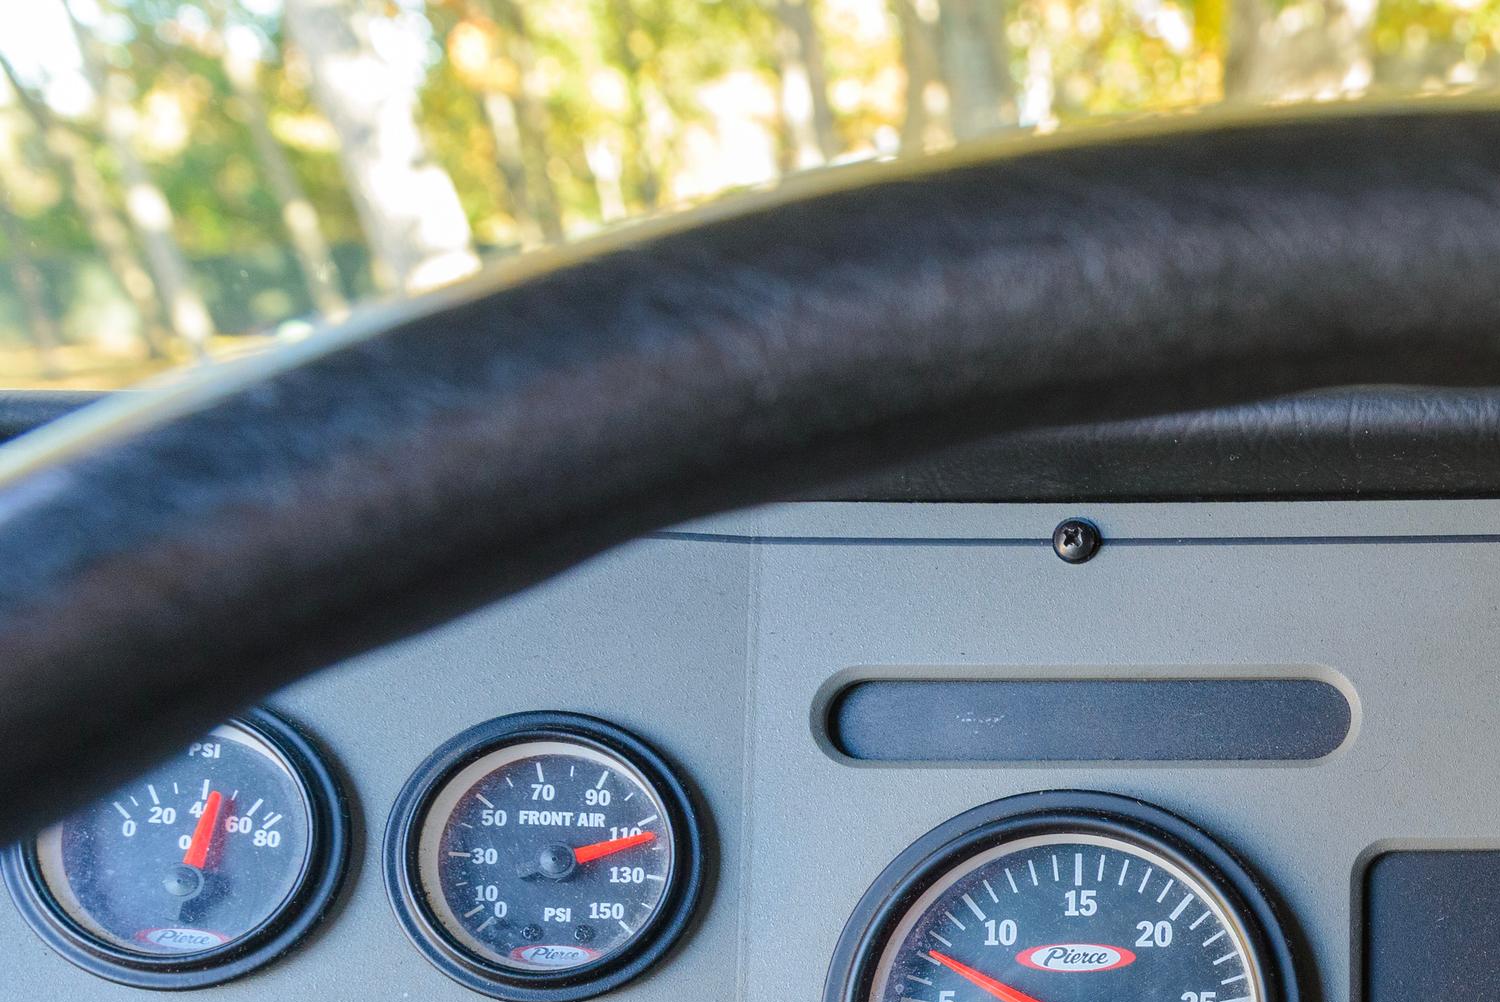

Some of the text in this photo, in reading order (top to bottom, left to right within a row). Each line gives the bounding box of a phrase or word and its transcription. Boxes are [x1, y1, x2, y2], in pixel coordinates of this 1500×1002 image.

[188, 743, 220, 759] PSI
[531, 784, 555, 801] 70
[585, 789, 611, 807] 90
[148, 807, 176, 824] 20
[481, 809, 507, 826] 50
[519, 810, 606, 828] FRONT AIR
[122, 820, 136, 836] 0
[225, 816, 252, 833] 60
[253, 830, 280, 847] 80
[472, 848, 498, 864] 30
[610, 866, 644, 883] 130
[476, 885, 498, 901] 10
[494, 902, 507, 918] 0
[589, 903, 624, 919] 150
[1064, 890, 1098, 916] 15
[544, 907, 571, 922] PSI
[156, 930, 210, 944] Pierce
[984, 920, 1017, 946] 10
[1135, 921, 1173, 948] 20
[530, 947, 579, 960] Pierce
[1042, 947, 1109, 966] Pierce
